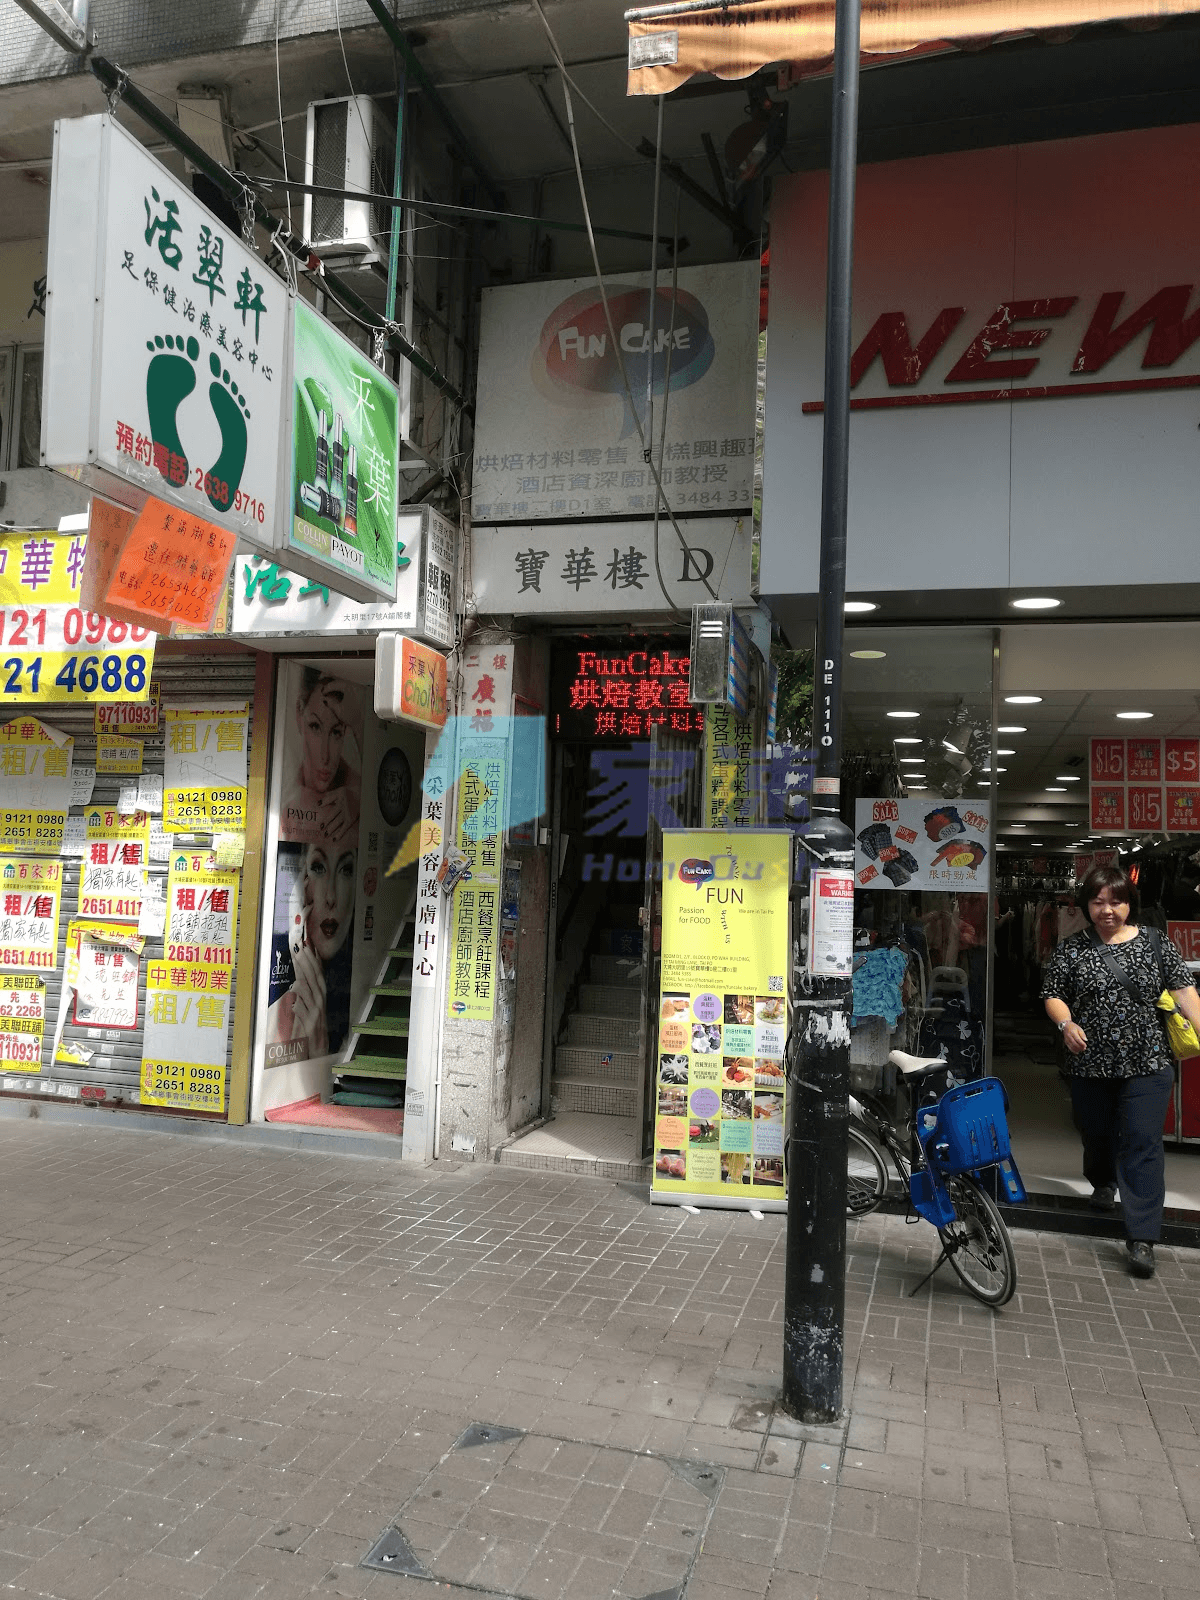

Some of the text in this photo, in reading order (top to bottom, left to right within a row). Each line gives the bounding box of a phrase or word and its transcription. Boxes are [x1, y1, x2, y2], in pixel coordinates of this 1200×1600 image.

[144, 186, 267, 346] 活翠軒
[849, 284, 1200, 389] NEW
[475, 447, 628, 473] 烘焙材料零售
[515, 463, 729, 495] 酒店資深廚師教授
[194, 467, 229, 504] 2638
[234, 489, 265, 523] 9716
[676, 491, 722, 505] 3484
[297, 521, 328, 546] COLLIN
[332, 539, 363, 566] PAYOT
[515, 546, 715, 594] 寶華樓 D
[4, 654, 146, 693] 21 4688
[577, 651, 691, 676] FunCake
[569, 679, 692, 710] 烘焙教室
[98, 706, 157, 724] 97110931
[1095, 744, 1122, 775] $15
[177, 791, 242, 803] 9121 0980
[1133, 791, 1161, 824] $15
[5, 813, 64, 825] 9121 0980
[177, 805, 242, 816] 2651 8283
[287, 807, 318, 823] PAYOT
[461, 762, 481, 866] 各式蛋糕課程
[481, 762, 501, 867] 烘焙材料零售
[873, 804, 899, 820] SALE
[962, 811, 988, 832] SALE
[4, 827, 63, 838] 2651 8283
[18, 863, 60, 880] 百家利
[416, 776, 443, 977] 采葉美容護膚中心
[82, 897, 113, 914] 2651
[706, 887, 743, 904] FUN
[679, 906, 705, 914] Passion
[689, 917, 711, 925] FOOD
[454, 890, 475, 998] 酒店廚師教授
[474, 891, 494, 999] 西餐烹飪課程
[28, 950, 54, 967] 4111
[95, 952, 125, 968] 租/售
[168, 945, 231, 965] 2651 4111
[150, 966, 229, 989] 中華物業
[16, 1005, 42, 1017] 2268
[149, 993, 226, 1029] 租/售
[268, 1041, 304, 1059] COLLIN
[156, 1064, 221, 1080] 9121 0980
[155, 1078, 220, 1095] 2651 8283
